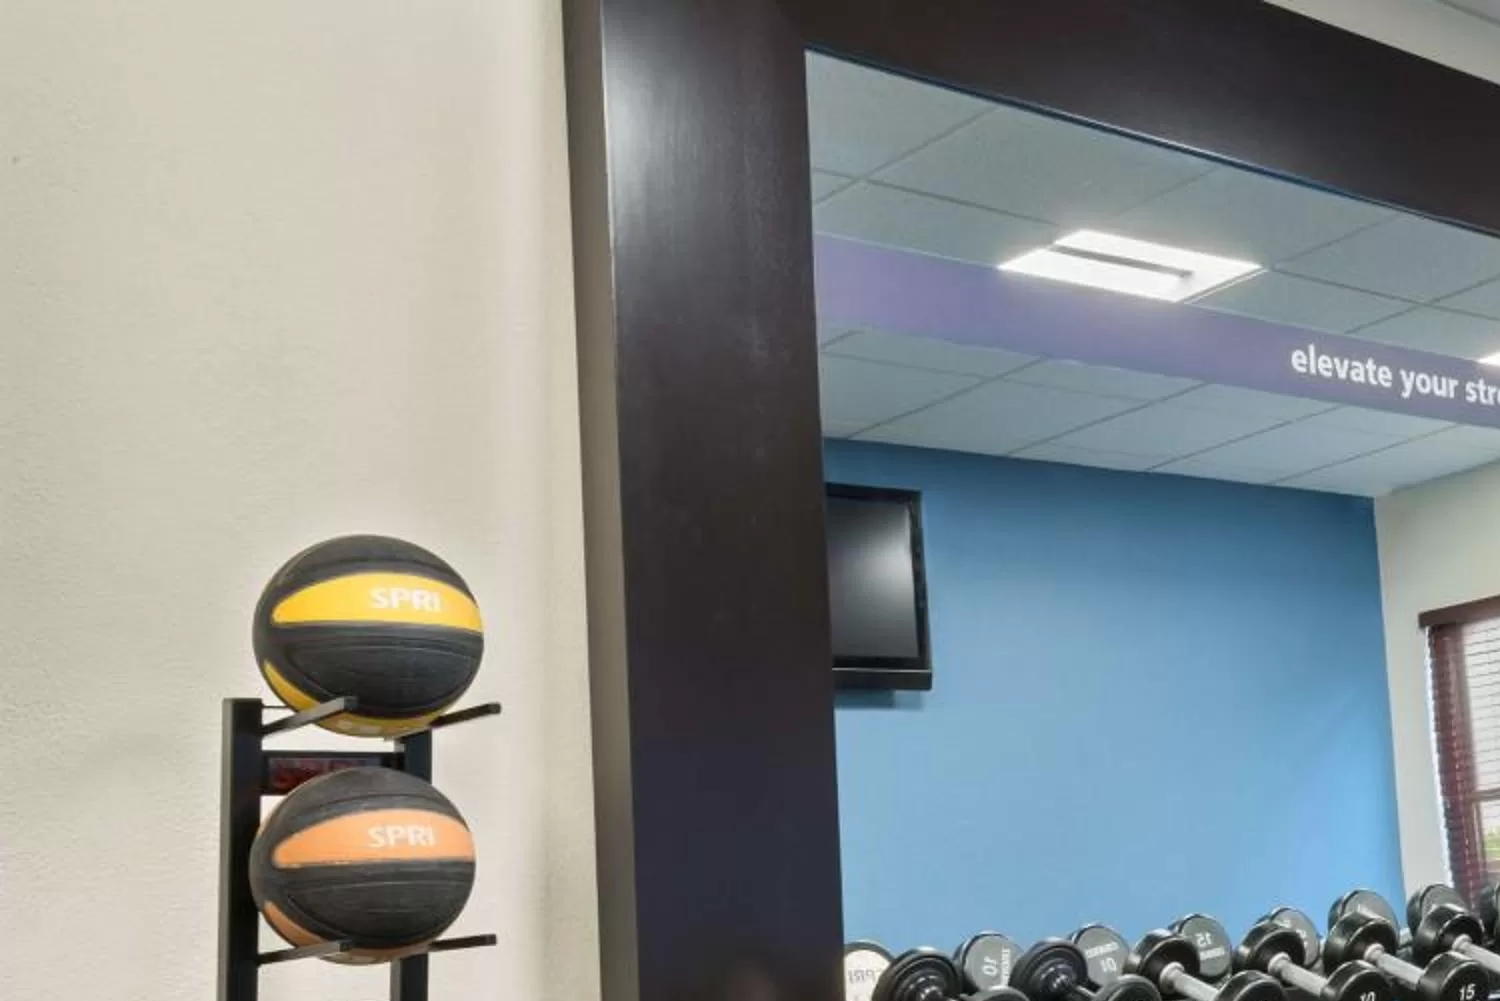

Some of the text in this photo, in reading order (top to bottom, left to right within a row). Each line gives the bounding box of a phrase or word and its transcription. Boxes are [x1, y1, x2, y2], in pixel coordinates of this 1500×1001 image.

[1291, 344, 1393, 387] elevate
[1400, 368, 1458, 399] your
[369, 586, 441, 613] SPRI
[367, 825, 436, 848] SPRI
[1459, 983, 1476, 1001] 15
